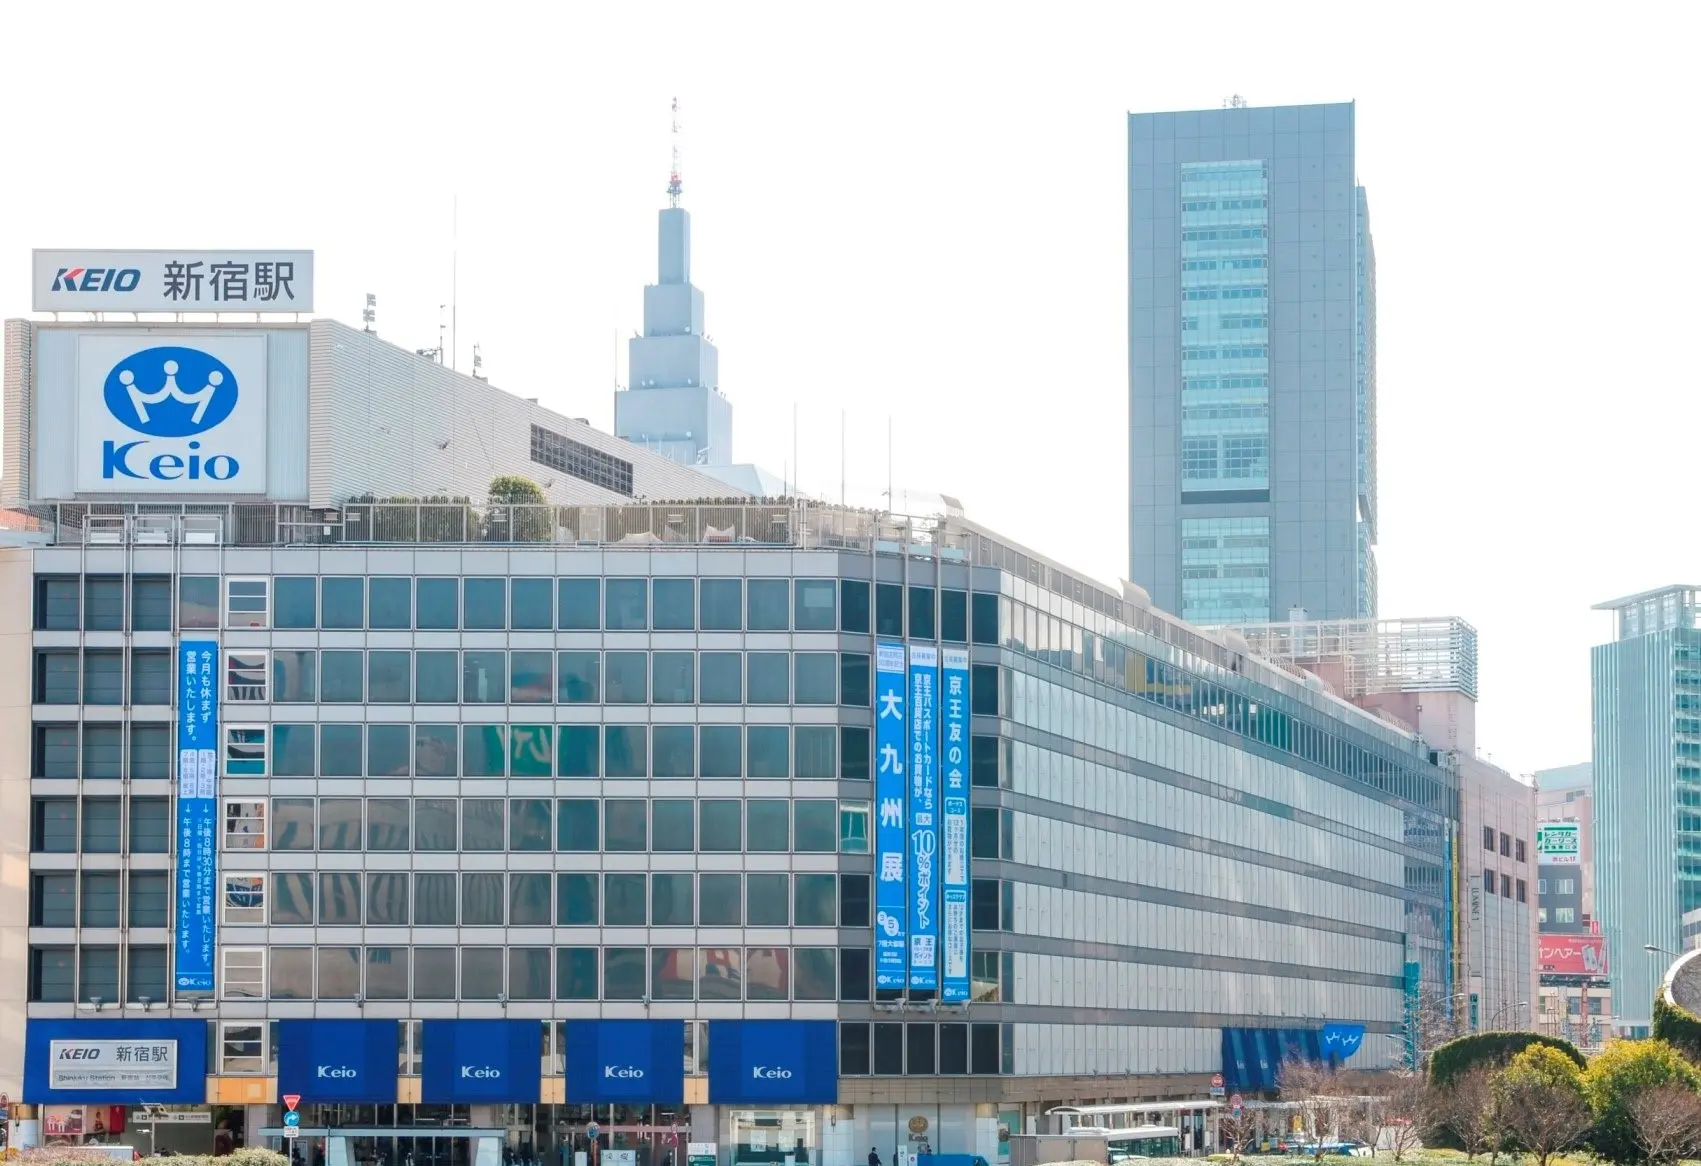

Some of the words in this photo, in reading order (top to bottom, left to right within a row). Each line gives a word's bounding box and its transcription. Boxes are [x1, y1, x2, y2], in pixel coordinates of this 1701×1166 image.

[51, 268, 141, 291] KEIO
[163, 260, 295, 301] 新宿駅
[103, 440, 240, 480] Keio
[186, 651, 197, 741] 営業いたします。
[201, 651, 212, 723] 今月も休まず
[922, 673, 933, 809] 京王パスポートカードなら
[949, 675, 962, 788] 京王友の会
[880, 689, 903, 882] 大九州展
[1471, 887, 1480, 916] LUMINE
[190, 977, 211, 986] Keio
[59, 1049, 100, 1060] KEIO
[116, 1047, 168, 1062] 新宿駅
[318, 1066, 356, 1078] Keio
[461, 1066, 500, 1078] Keio
[605, 1066, 644, 1078] Keio
[753, 1067, 792, 1079] Keio
